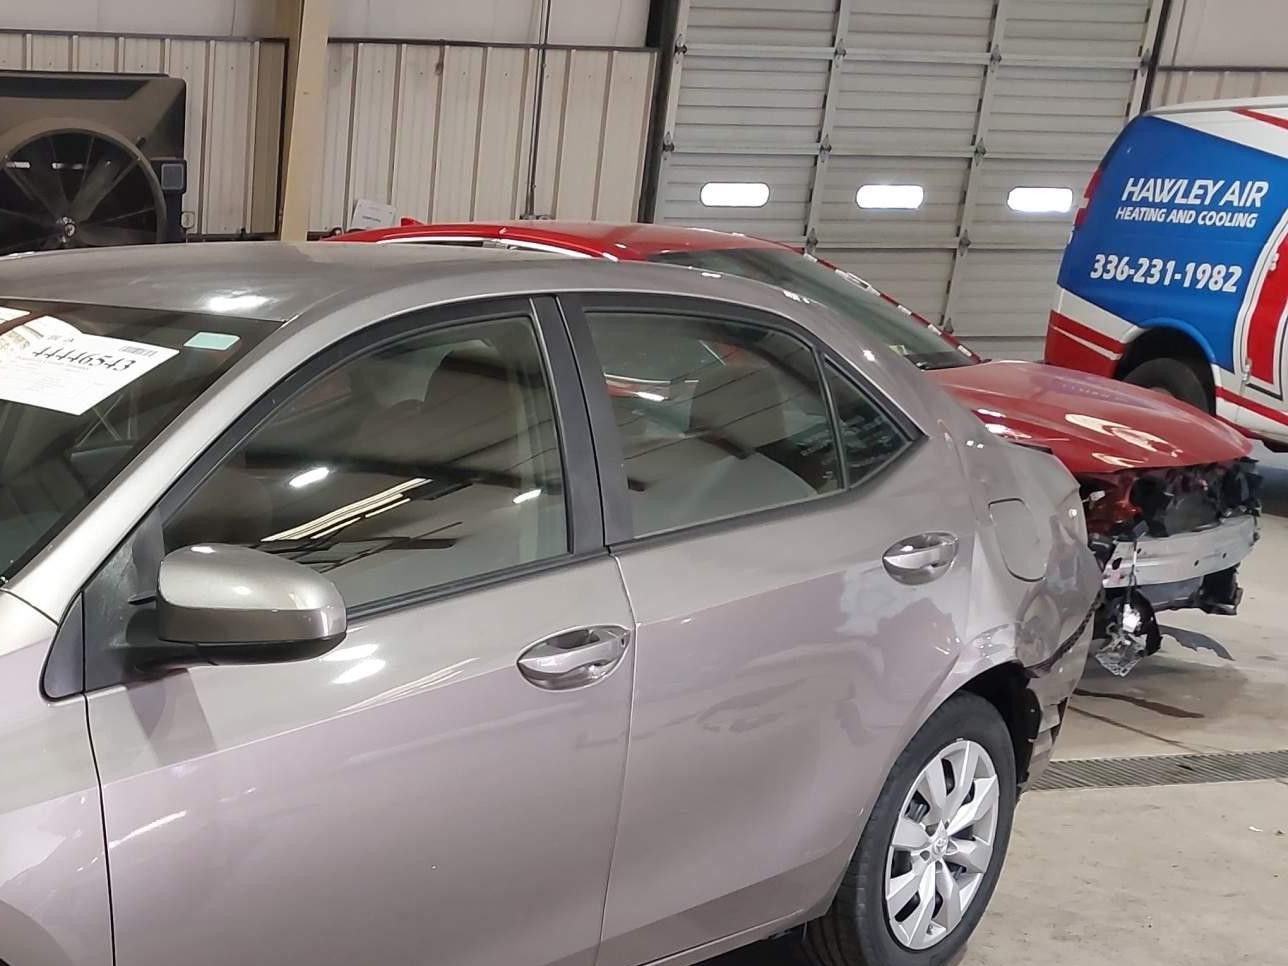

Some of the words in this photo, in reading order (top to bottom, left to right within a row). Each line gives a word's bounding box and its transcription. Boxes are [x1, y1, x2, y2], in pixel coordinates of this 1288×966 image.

[1121, 177, 1224, 206] HAWLEY
[1219, 180, 1269, 207] AIR
[1115, 206, 1167, 223] HEATING
[1166, 209, 1196, 225] AND
[1197, 211, 1258, 228] COOLING
[1090, 254, 1242, 293] 336-231-1982
[31, 346, 137, 371] 44446543
